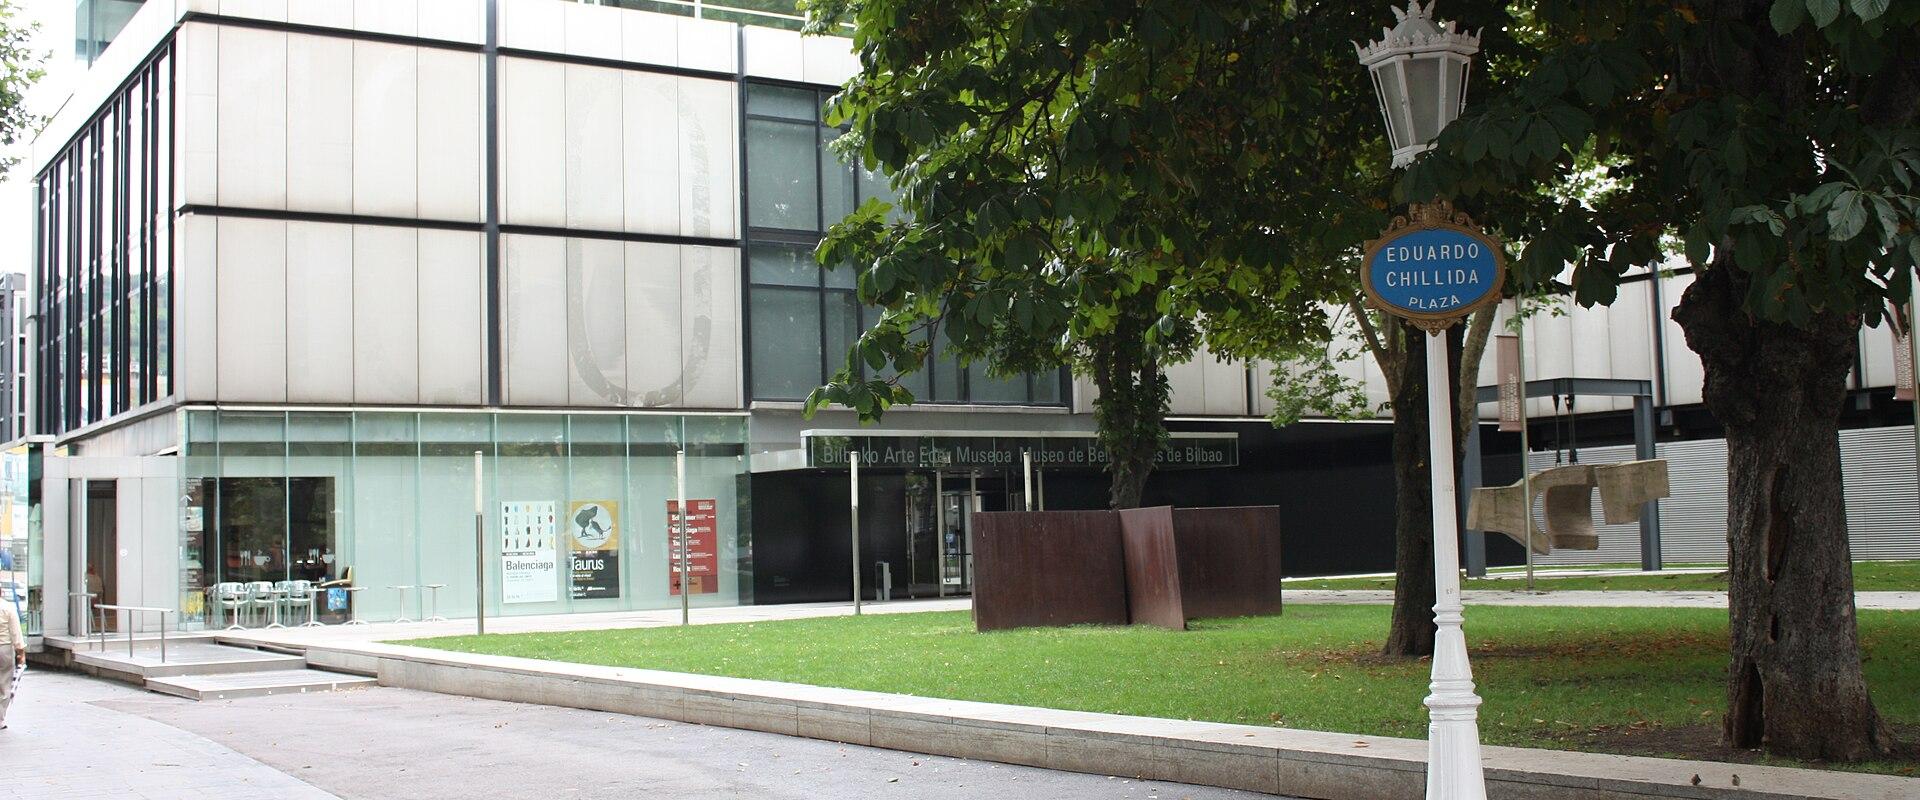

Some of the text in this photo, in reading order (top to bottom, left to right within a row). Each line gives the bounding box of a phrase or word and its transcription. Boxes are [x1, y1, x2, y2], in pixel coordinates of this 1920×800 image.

[1386, 243, 1479, 262] EDUARDO
[1386, 269, 1479, 287] CHILLIDA
[1408, 294, 1461, 309] PLAZA
[884, 446, 915, 463] Arte
[956, 446, 1012, 463] Museoa
[1019, 446, 1064, 463] Museo
[1068, 445, 1084, 463] de
[1167, 445, 1181, 462] de
[1186, 446, 1223, 462] Bilbao
[506, 559, 554, 571] Balenciaga
[569, 556, 604, 571] Taurus
